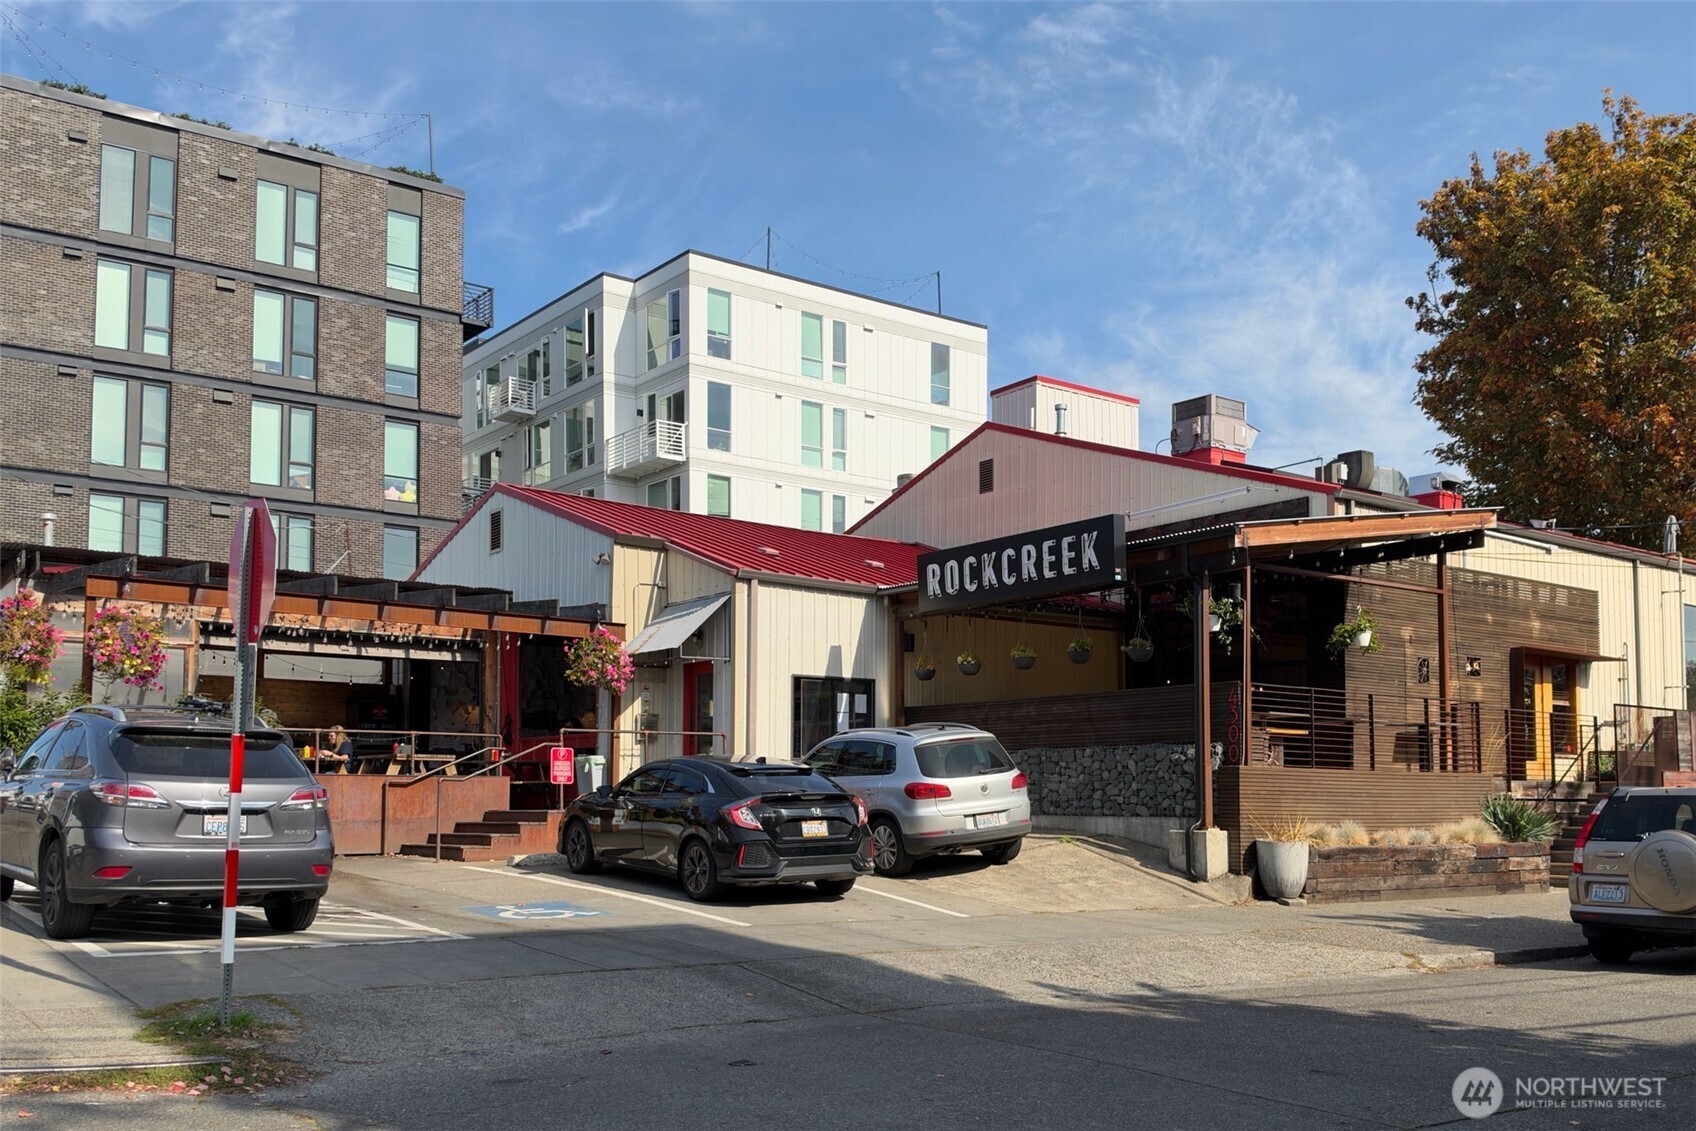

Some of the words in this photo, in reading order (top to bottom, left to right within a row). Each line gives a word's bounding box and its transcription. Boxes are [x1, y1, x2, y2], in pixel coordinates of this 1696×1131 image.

[926, 531, 1101, 598] ROCKCREEK
[1228, 687, 1239, 762] 4300
[1656, 848, 1681, 897] HONDA
